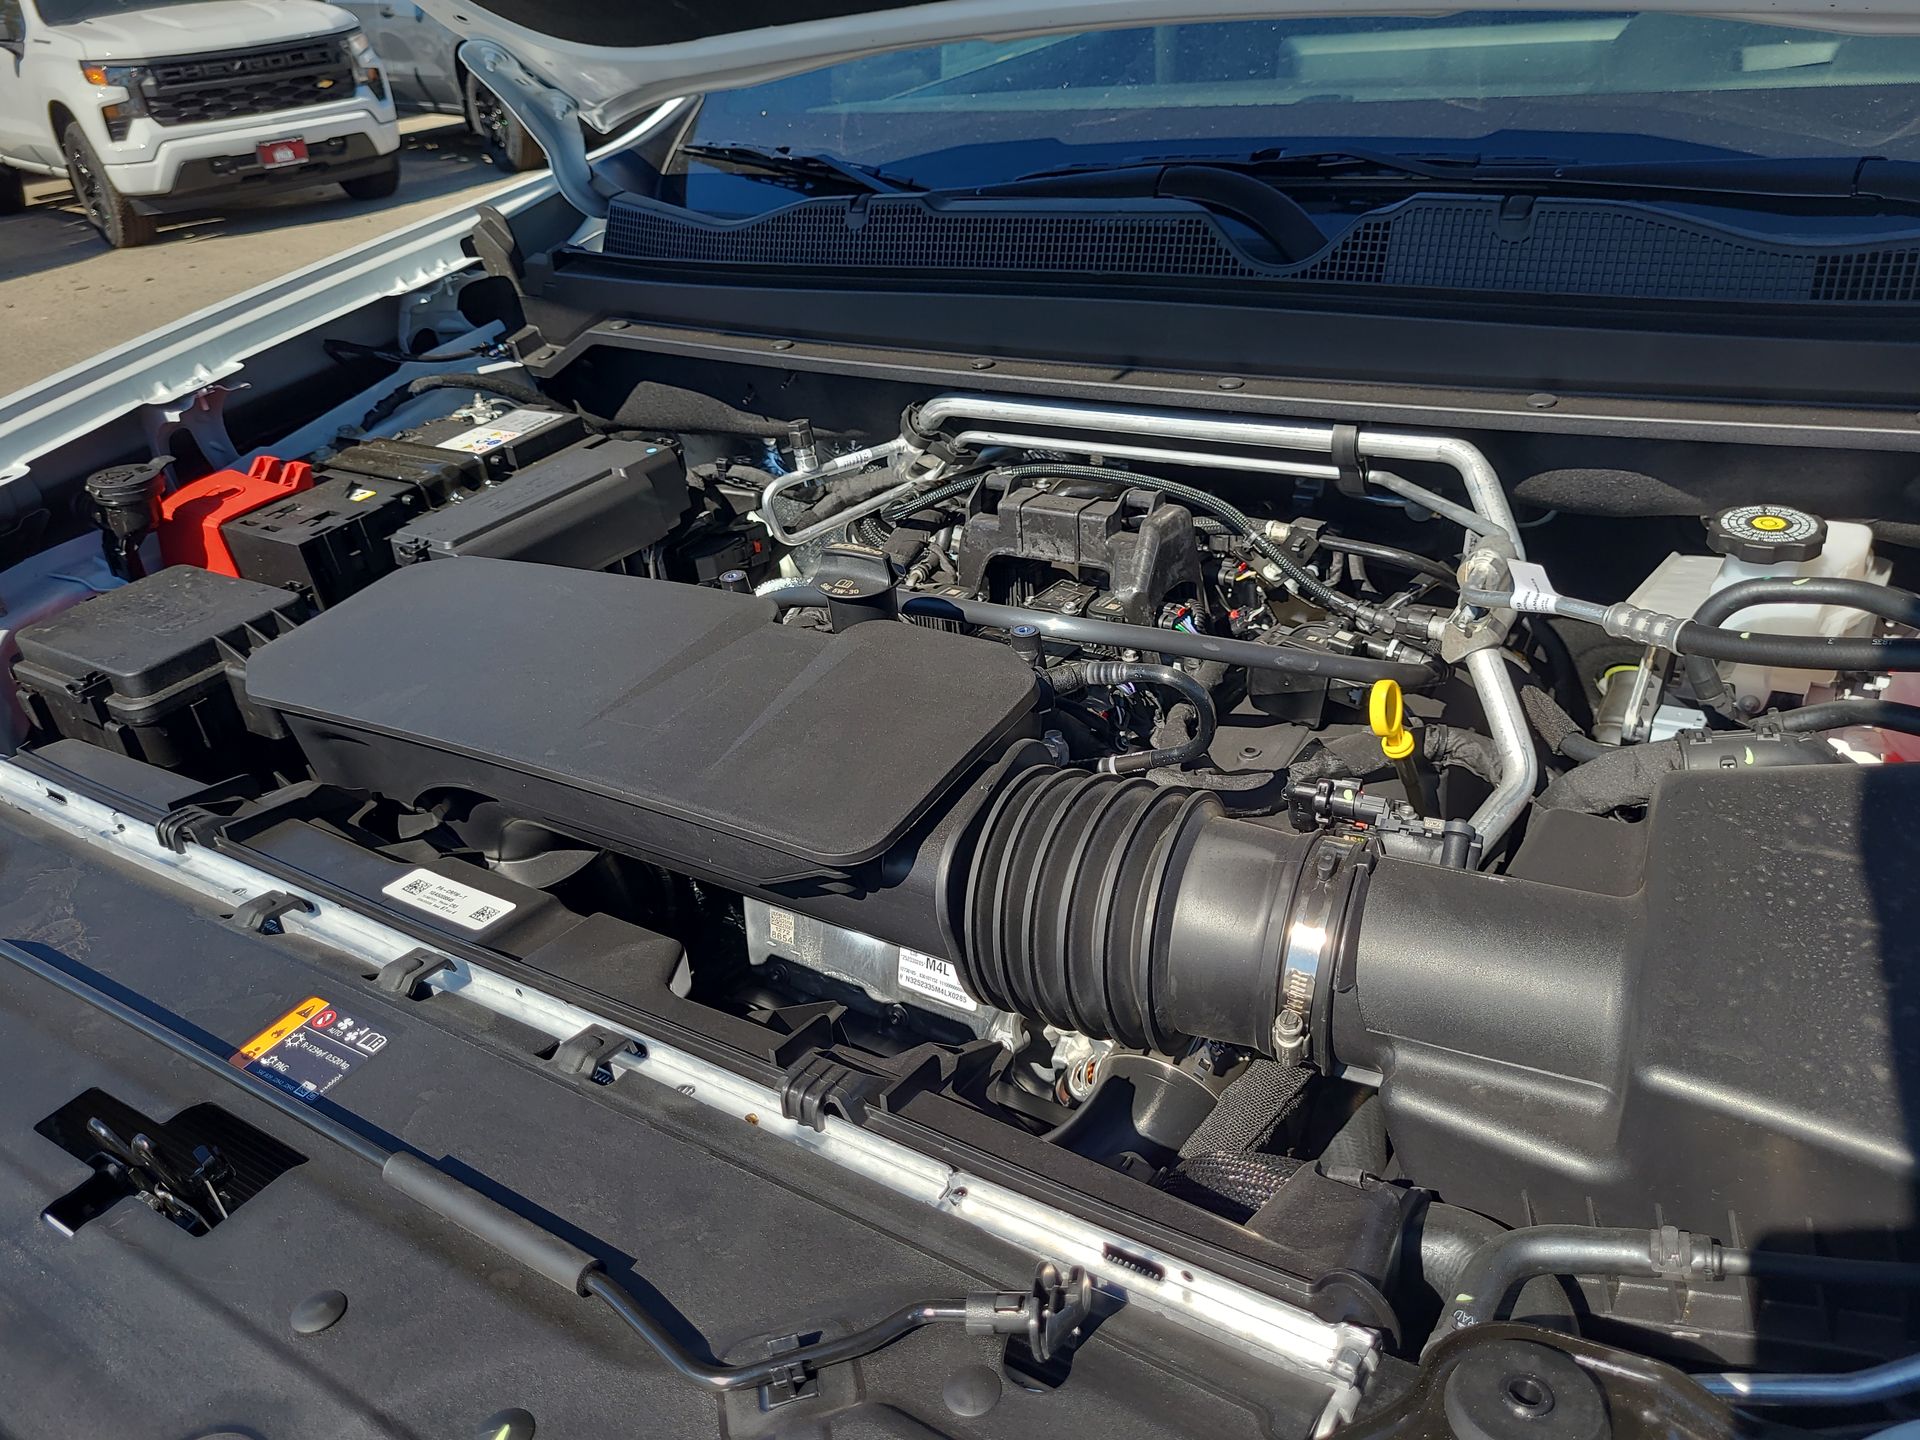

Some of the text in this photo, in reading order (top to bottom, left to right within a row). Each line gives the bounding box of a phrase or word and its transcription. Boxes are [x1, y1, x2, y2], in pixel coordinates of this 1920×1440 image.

[820, 582, 833, 591] SAE
[925, 957, 950, 977] M4L
[327, 1027, 344, 1037] AUTO
[300, 1041, 328, 1058] R-1234yf
[340, 1061, 350, 1070] kg
[274, 1060, 290, 1072] PAG
